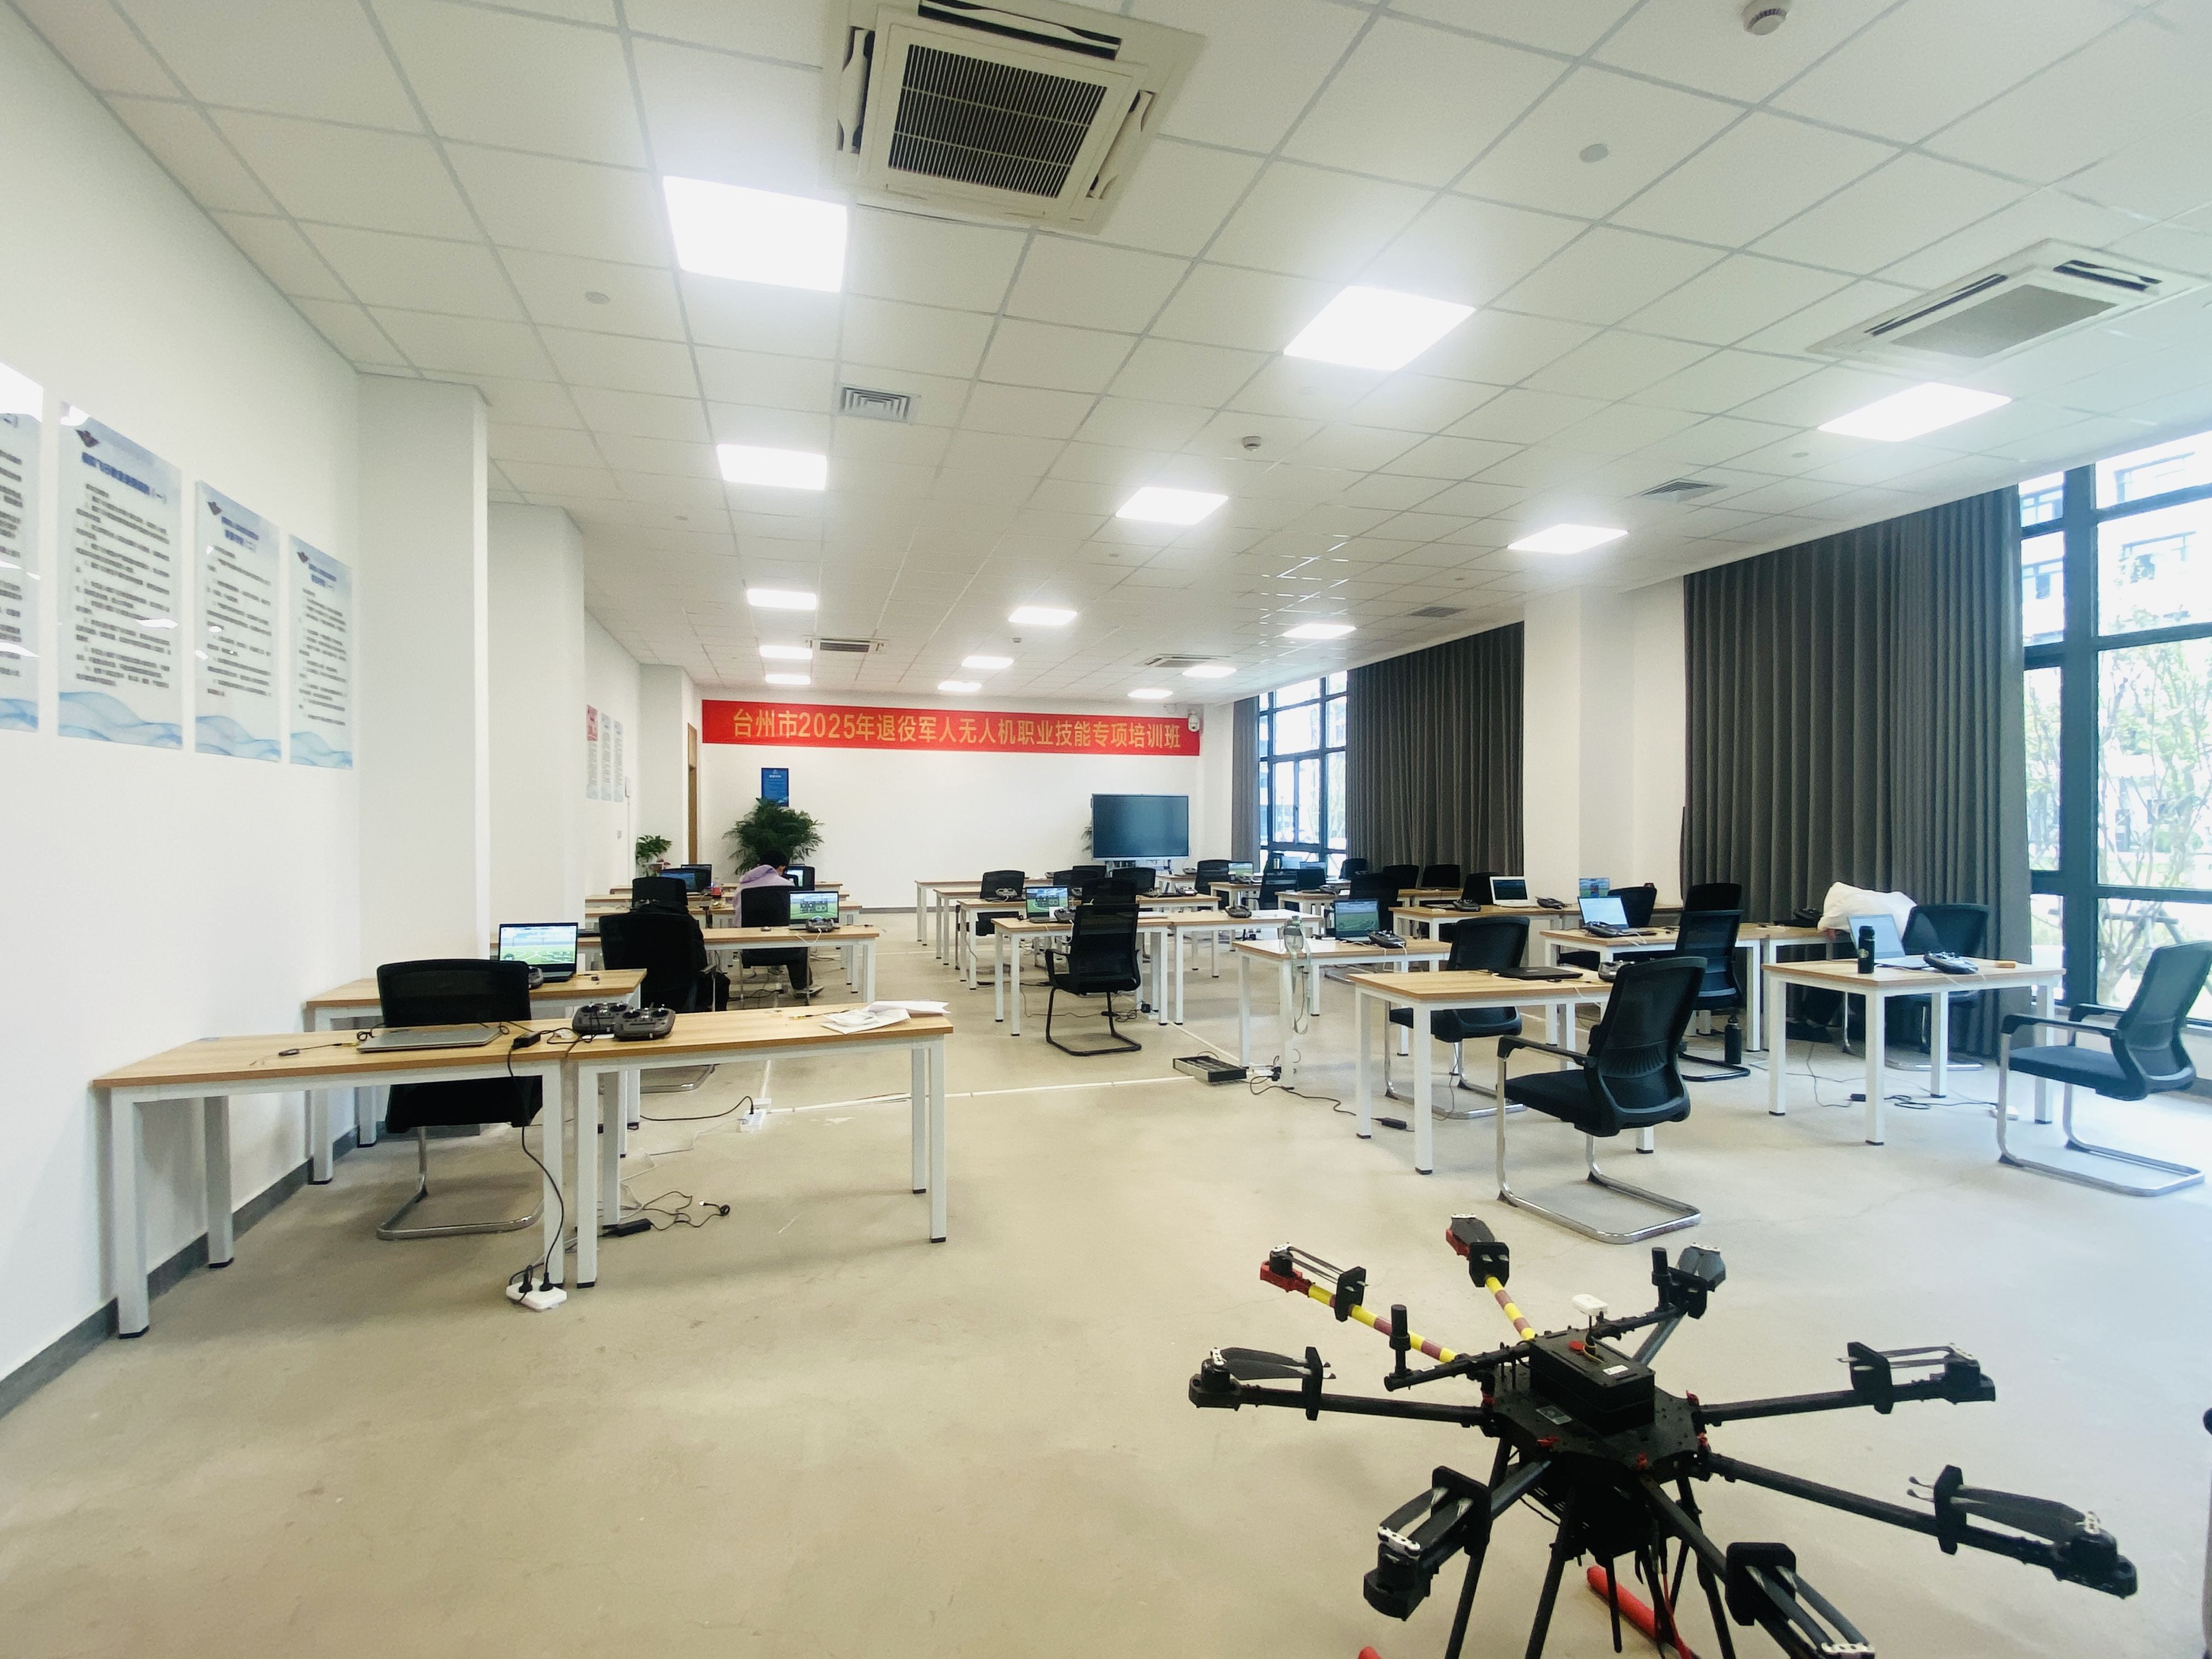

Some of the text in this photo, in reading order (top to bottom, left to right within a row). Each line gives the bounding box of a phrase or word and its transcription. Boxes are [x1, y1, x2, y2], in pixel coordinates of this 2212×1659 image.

[733, 709, 1181, 748] 台州市2025年退役军人无人机职业技能专项培训班
